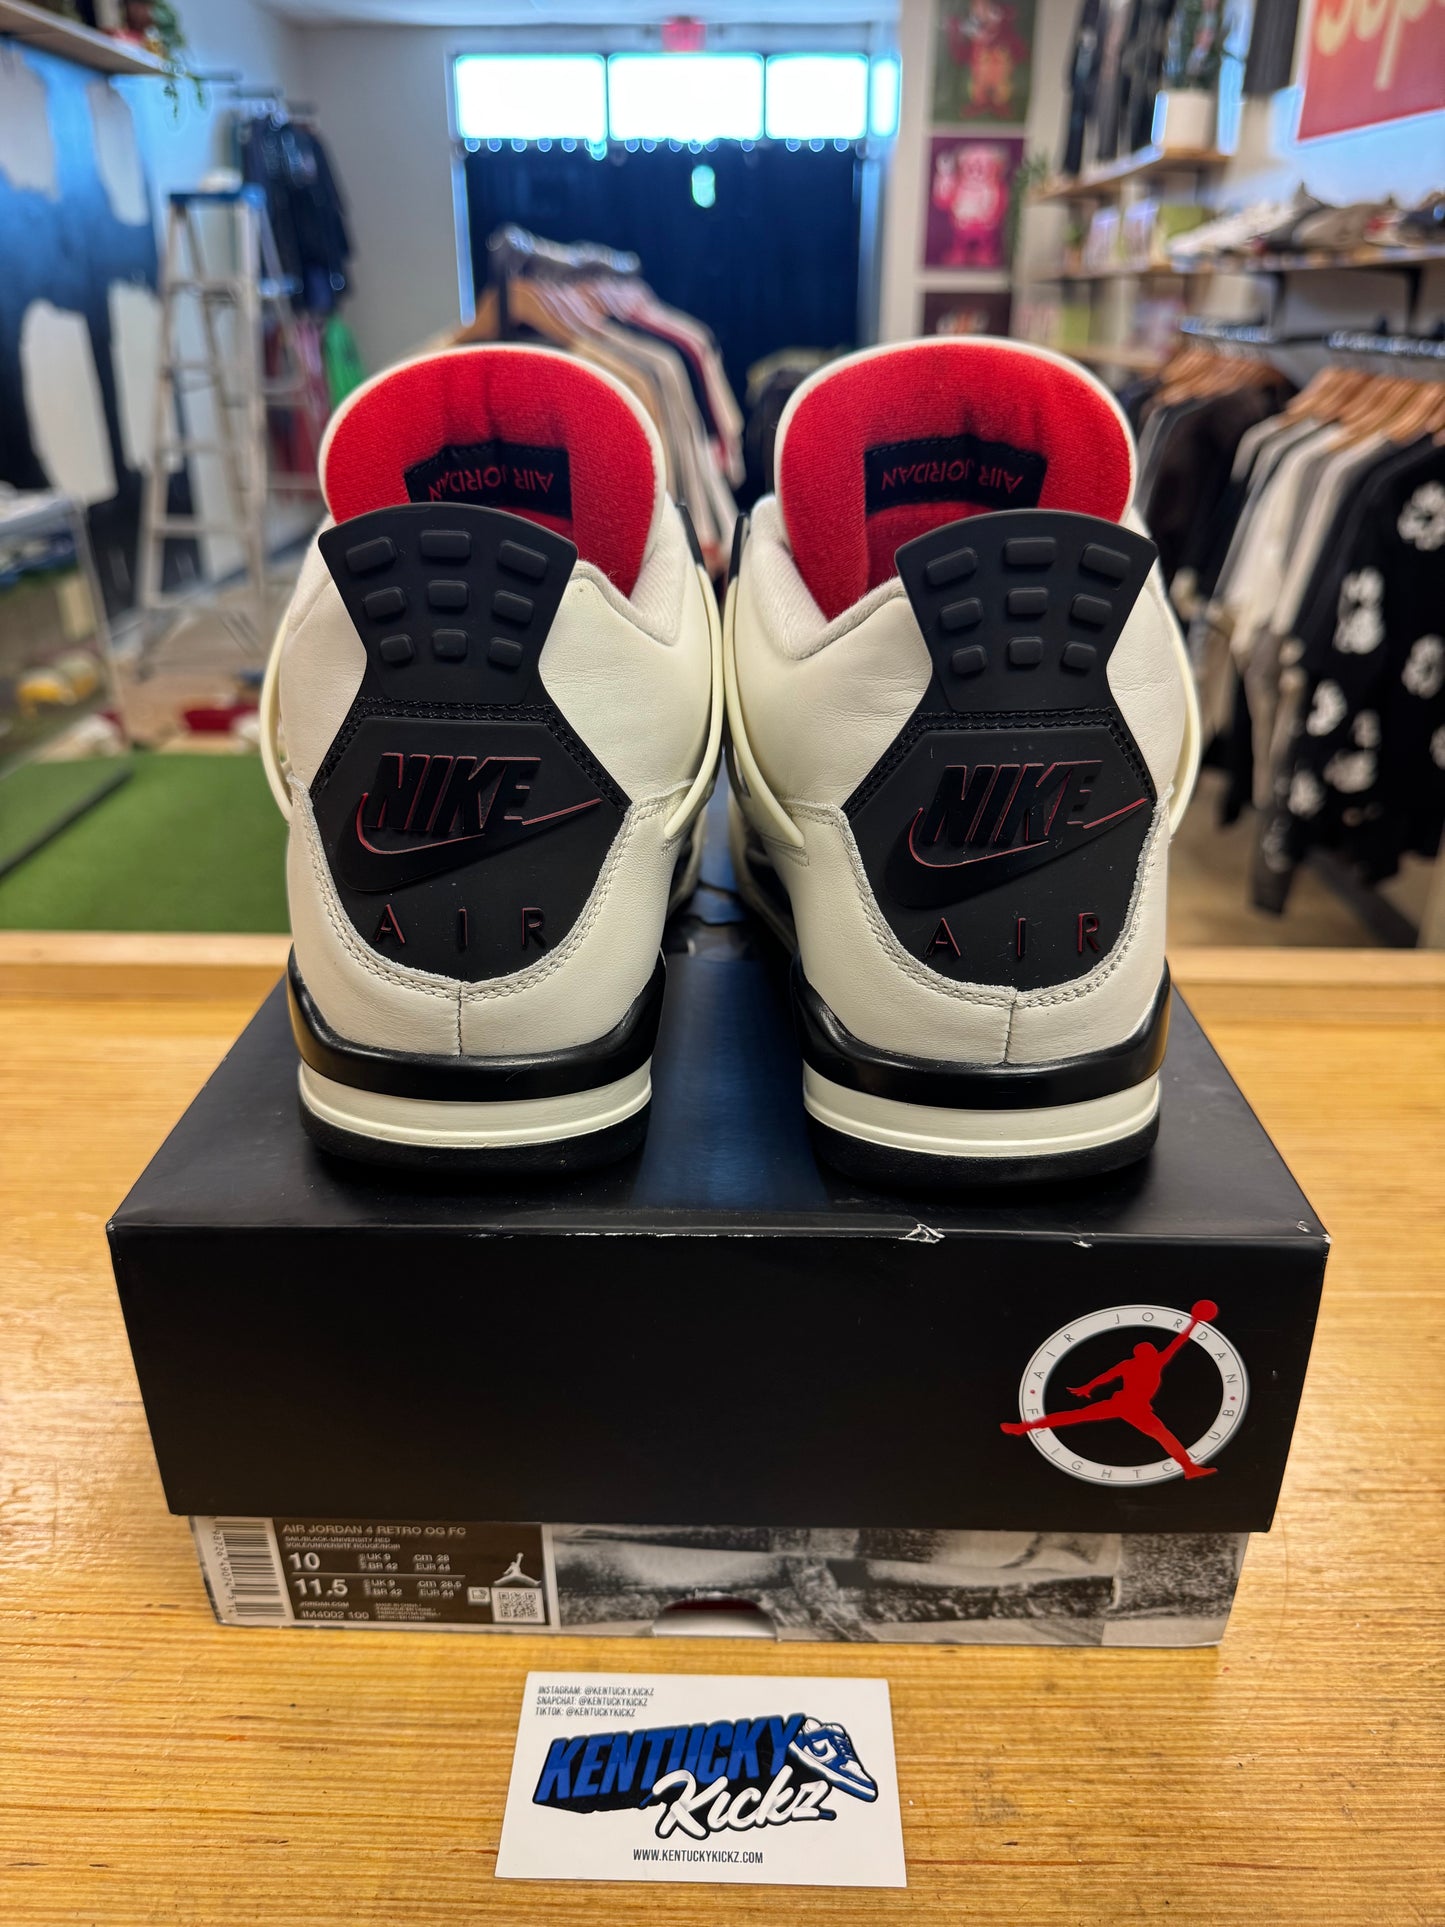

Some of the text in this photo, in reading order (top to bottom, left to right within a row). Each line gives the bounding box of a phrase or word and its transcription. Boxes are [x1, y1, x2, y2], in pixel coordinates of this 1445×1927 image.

[427, 464, 555, 502] AIR JORDAN
[880, 457, 1024, 494] AIR JORDAN
[363, 751, 542, 836] NIKE
[919, 759, 1104, 849] NIKE
[375, 903, 548, 950] AIR
[925, 911, 1101, 958] AIR
[1033, 1311, 1240, 1385] AIR JORDAN
[1026, 1407, 1236, 1479] FLIGHT CLUB
[283, 1524, 467, 1536] AIR JORDAN 4 RETRO OG FC
[289, 1551, 321, 1571] 10
[367, 1553, 382, 1561] UK
[385, 1562, 399, 1571] 42
[436, 1553, 450, 1562] 28
[415, 1562, 451, 1572] EUR 44
[293, 1578, 349, 1597] 11.5
[371, 1579, 387, 1588] UK
[389, 1588, 403, 1597] 42
[537, 1685, 583, 1695] INSTAGRAM:
[536, 1696, 648, 1707] SNAPCHAT: @KENTUCKYKICKZ
[535, 1706, 636, 1718] TIKTOK: @KENTUCKYKICKZ
[534, 1713, 806, 1804] KENTUCKY
[652, 1765, 828, 1838] Kickz
[632, 1848, 764, 1865] WWW.KENTUCKYKICKZ.COM
